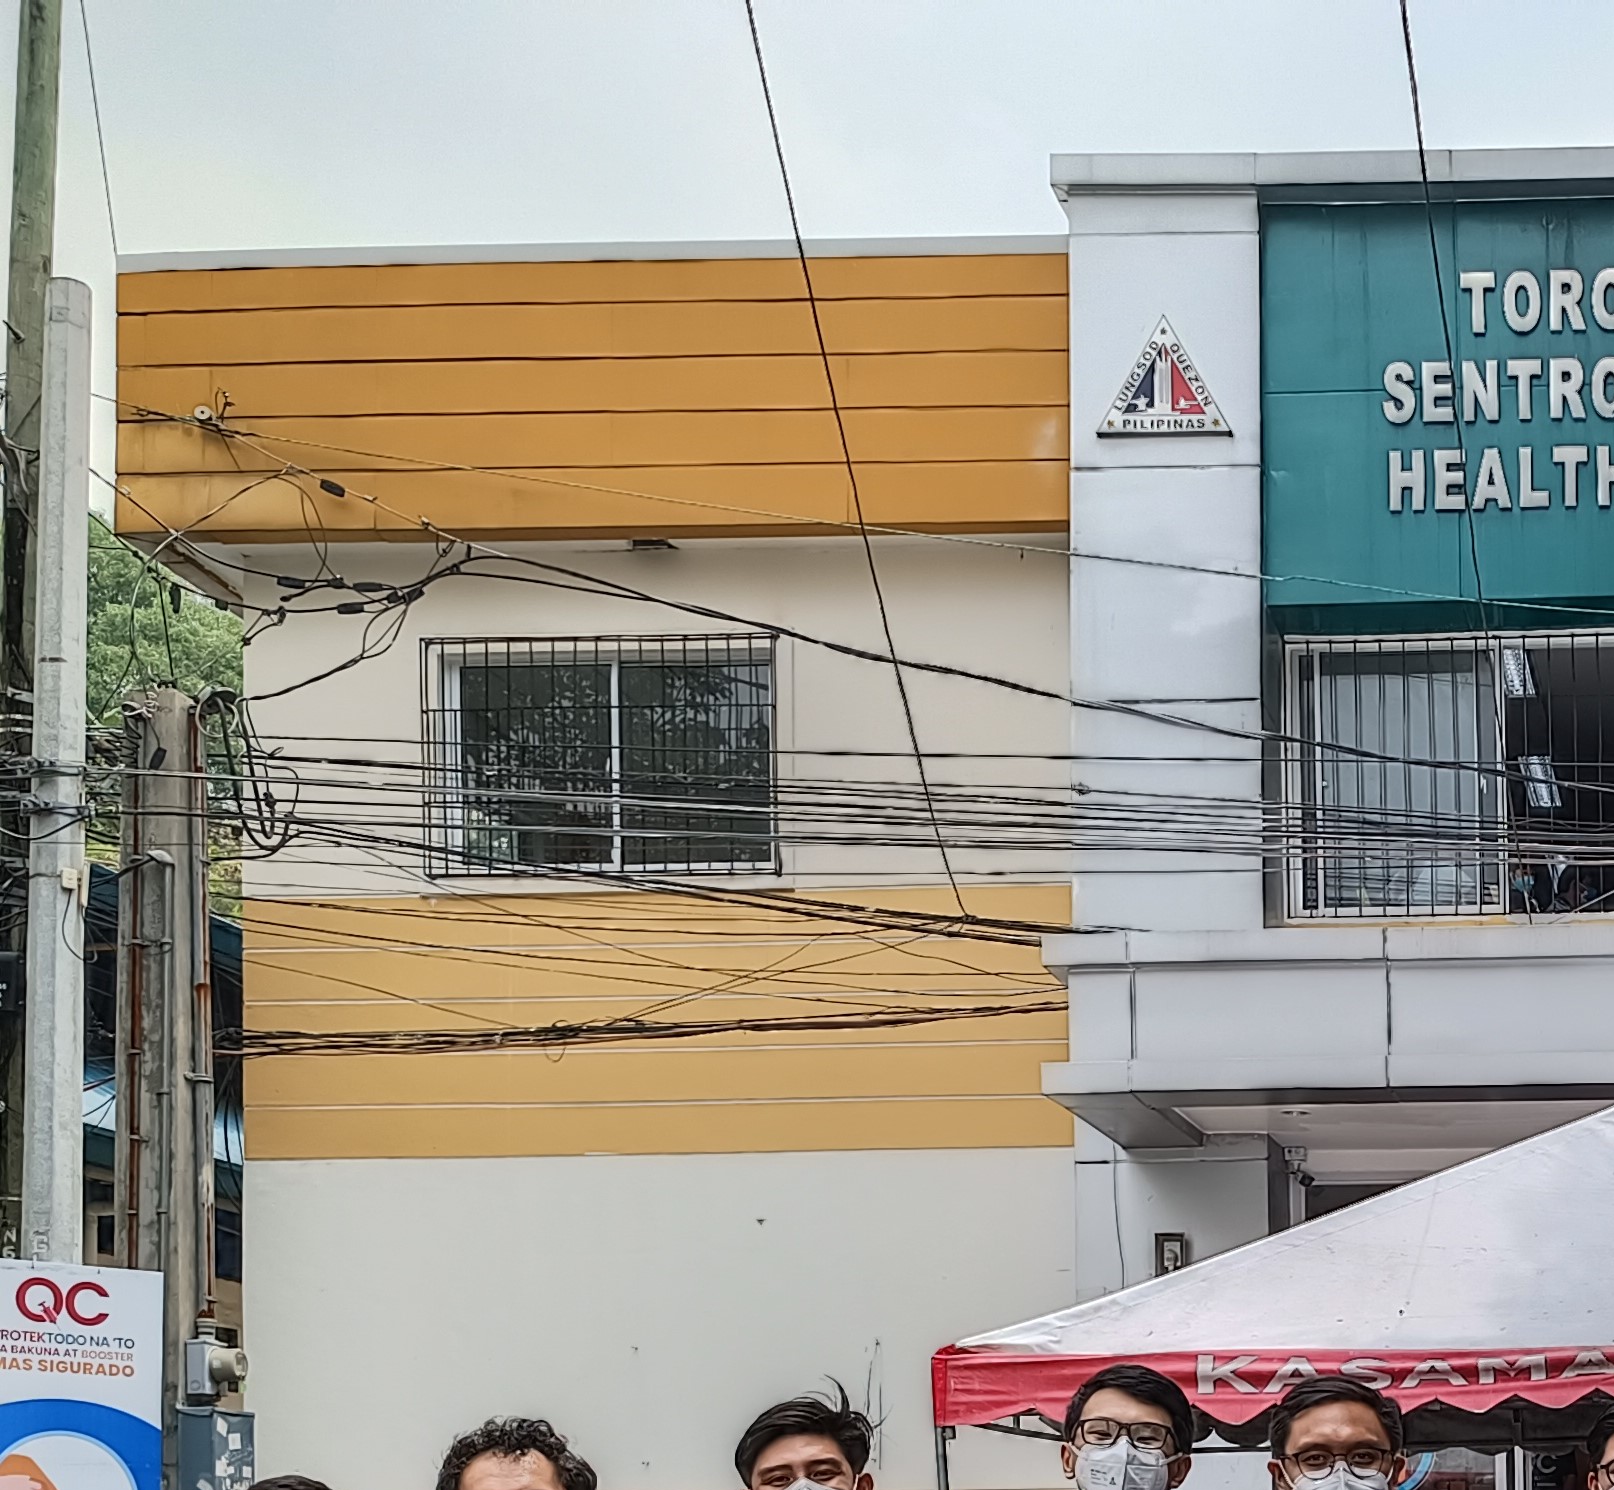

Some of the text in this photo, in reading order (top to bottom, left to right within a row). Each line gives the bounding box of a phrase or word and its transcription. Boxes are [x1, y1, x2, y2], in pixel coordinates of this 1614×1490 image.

[1113, 340, 1160, 411] LUNGSOD
[1169, 342, 1212, 407] QUEZON
[1122, 418, 1206, 430] PILIPINAS
[15, 1277, 110, 1328] QC
[0, 1329, 87, 1346] ROTEKTODO
[89, 1335, 110, 1348] NA
[11, 1345, 61, 1357] BAKUNA
[63, 1349, 79, 1358] AT
[81, 1350, 134, 1362] BOOSTER
[37, 1358, 135, 1378] SIGURADO
